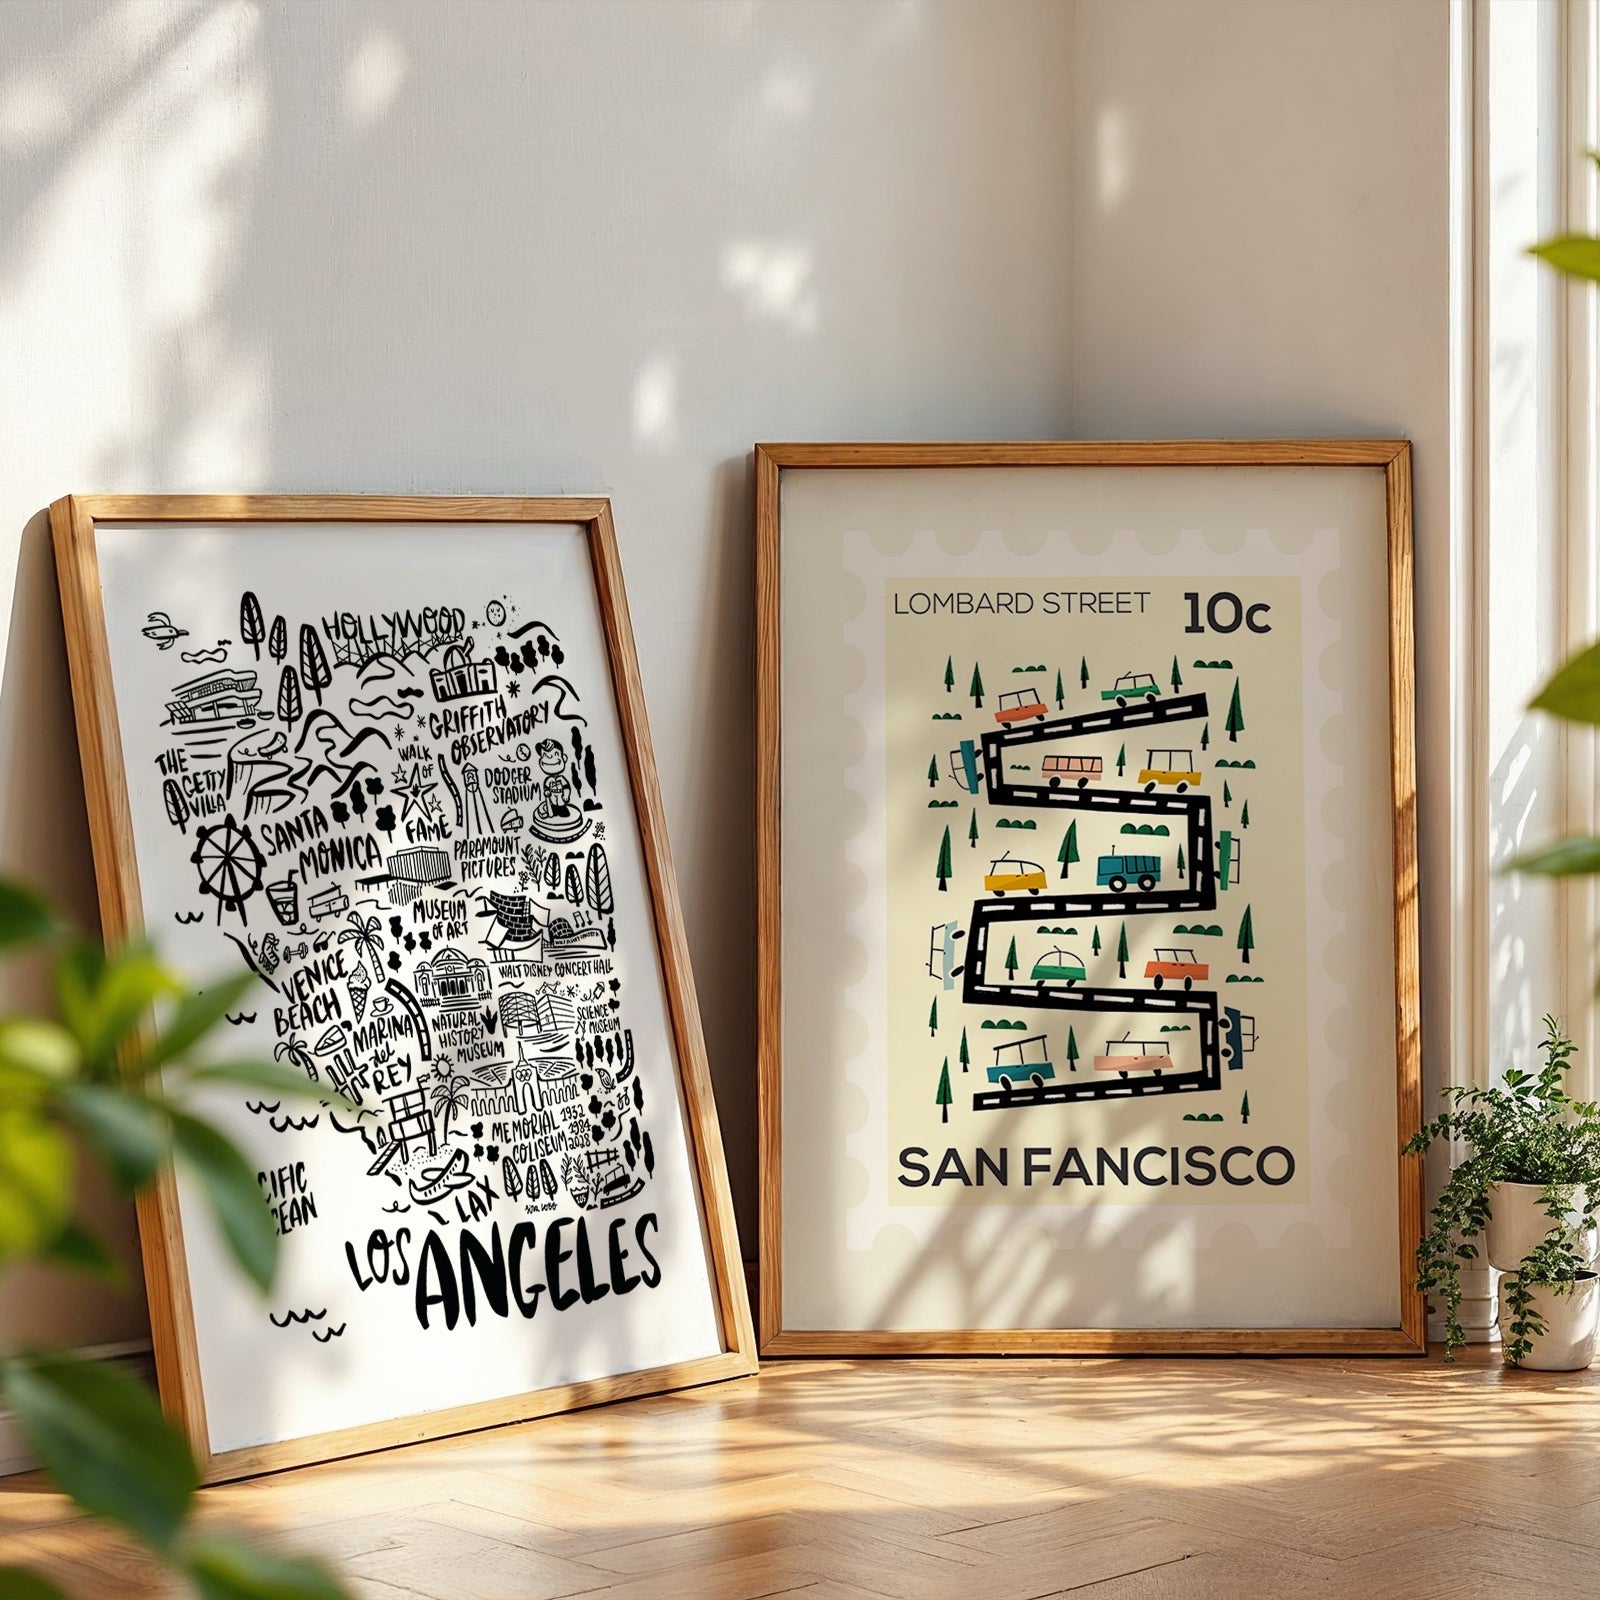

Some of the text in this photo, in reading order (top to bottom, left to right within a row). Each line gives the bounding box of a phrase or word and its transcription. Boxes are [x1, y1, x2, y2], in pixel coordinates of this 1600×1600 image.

[894, 591, 1151, 614] LOMBARD STREET
[1183, 591, 1273, 634] 10c
[322, 607, 466, 648] HOLLYWOOD
[429, 694, 507, 741] GRIFFITH
[450, 701, 550, 765] OBSERVATORY
[155, 749, 188, 776] THE
[398, 744, 433, 762] WALK
[182, 768, 226, 795] GETTY
[422, 764, 434, 779] OF
[484, 766, 532, 788] DODGER
[187, 793, 226, 818] VILLA
[492, 782, 541, 804] STADIUM
[260, 806, 330, 857] SANTA
[406, 814, 452, 844] FAME
[299, 833, 383, 885] MONICA
[454, 836, 521, 862] PARAMOUNT
[461, 857, 516, 882] PICTURES
[413, 899, 467, 924] MUSEUM
[432, 921, 469, 941] OF ART
[281, 949, 349, 1004] VENICE
[498, 958, 614, 979] WALT DISNEY CONCERT HALL
[274, 987, 342, 1037] BEACH
[431, 1011, 480, 1033] NATURAL
[577, 1003, 608, 1021] SCIENCE
[589, 1016, 621, 1034] MUSEUM
[352, 1015, 414, 1057] MARINA
[439, 1025, 484, 1049] HISTORY
[369, 1041, 395, 1068] del
[457, 1041, 505, 1063] MUSEUM
[372, 1053, 412, 1095] REY
[560, 1104, 586, 1122] 1932
[492, 1110, 560, 1144] MEMORIAL
[567, 1120, 592, 1136] 1984
[513, 1132, 568, 1165] COLISEUM
[568, 1133, 591, 1149] 2028
[896, 1145, 1296, 1188] SAN FANCISCO
[455, 1174, 500, 1223] LAX
[345, 1211, 661, 1330] LOS ANGELES
